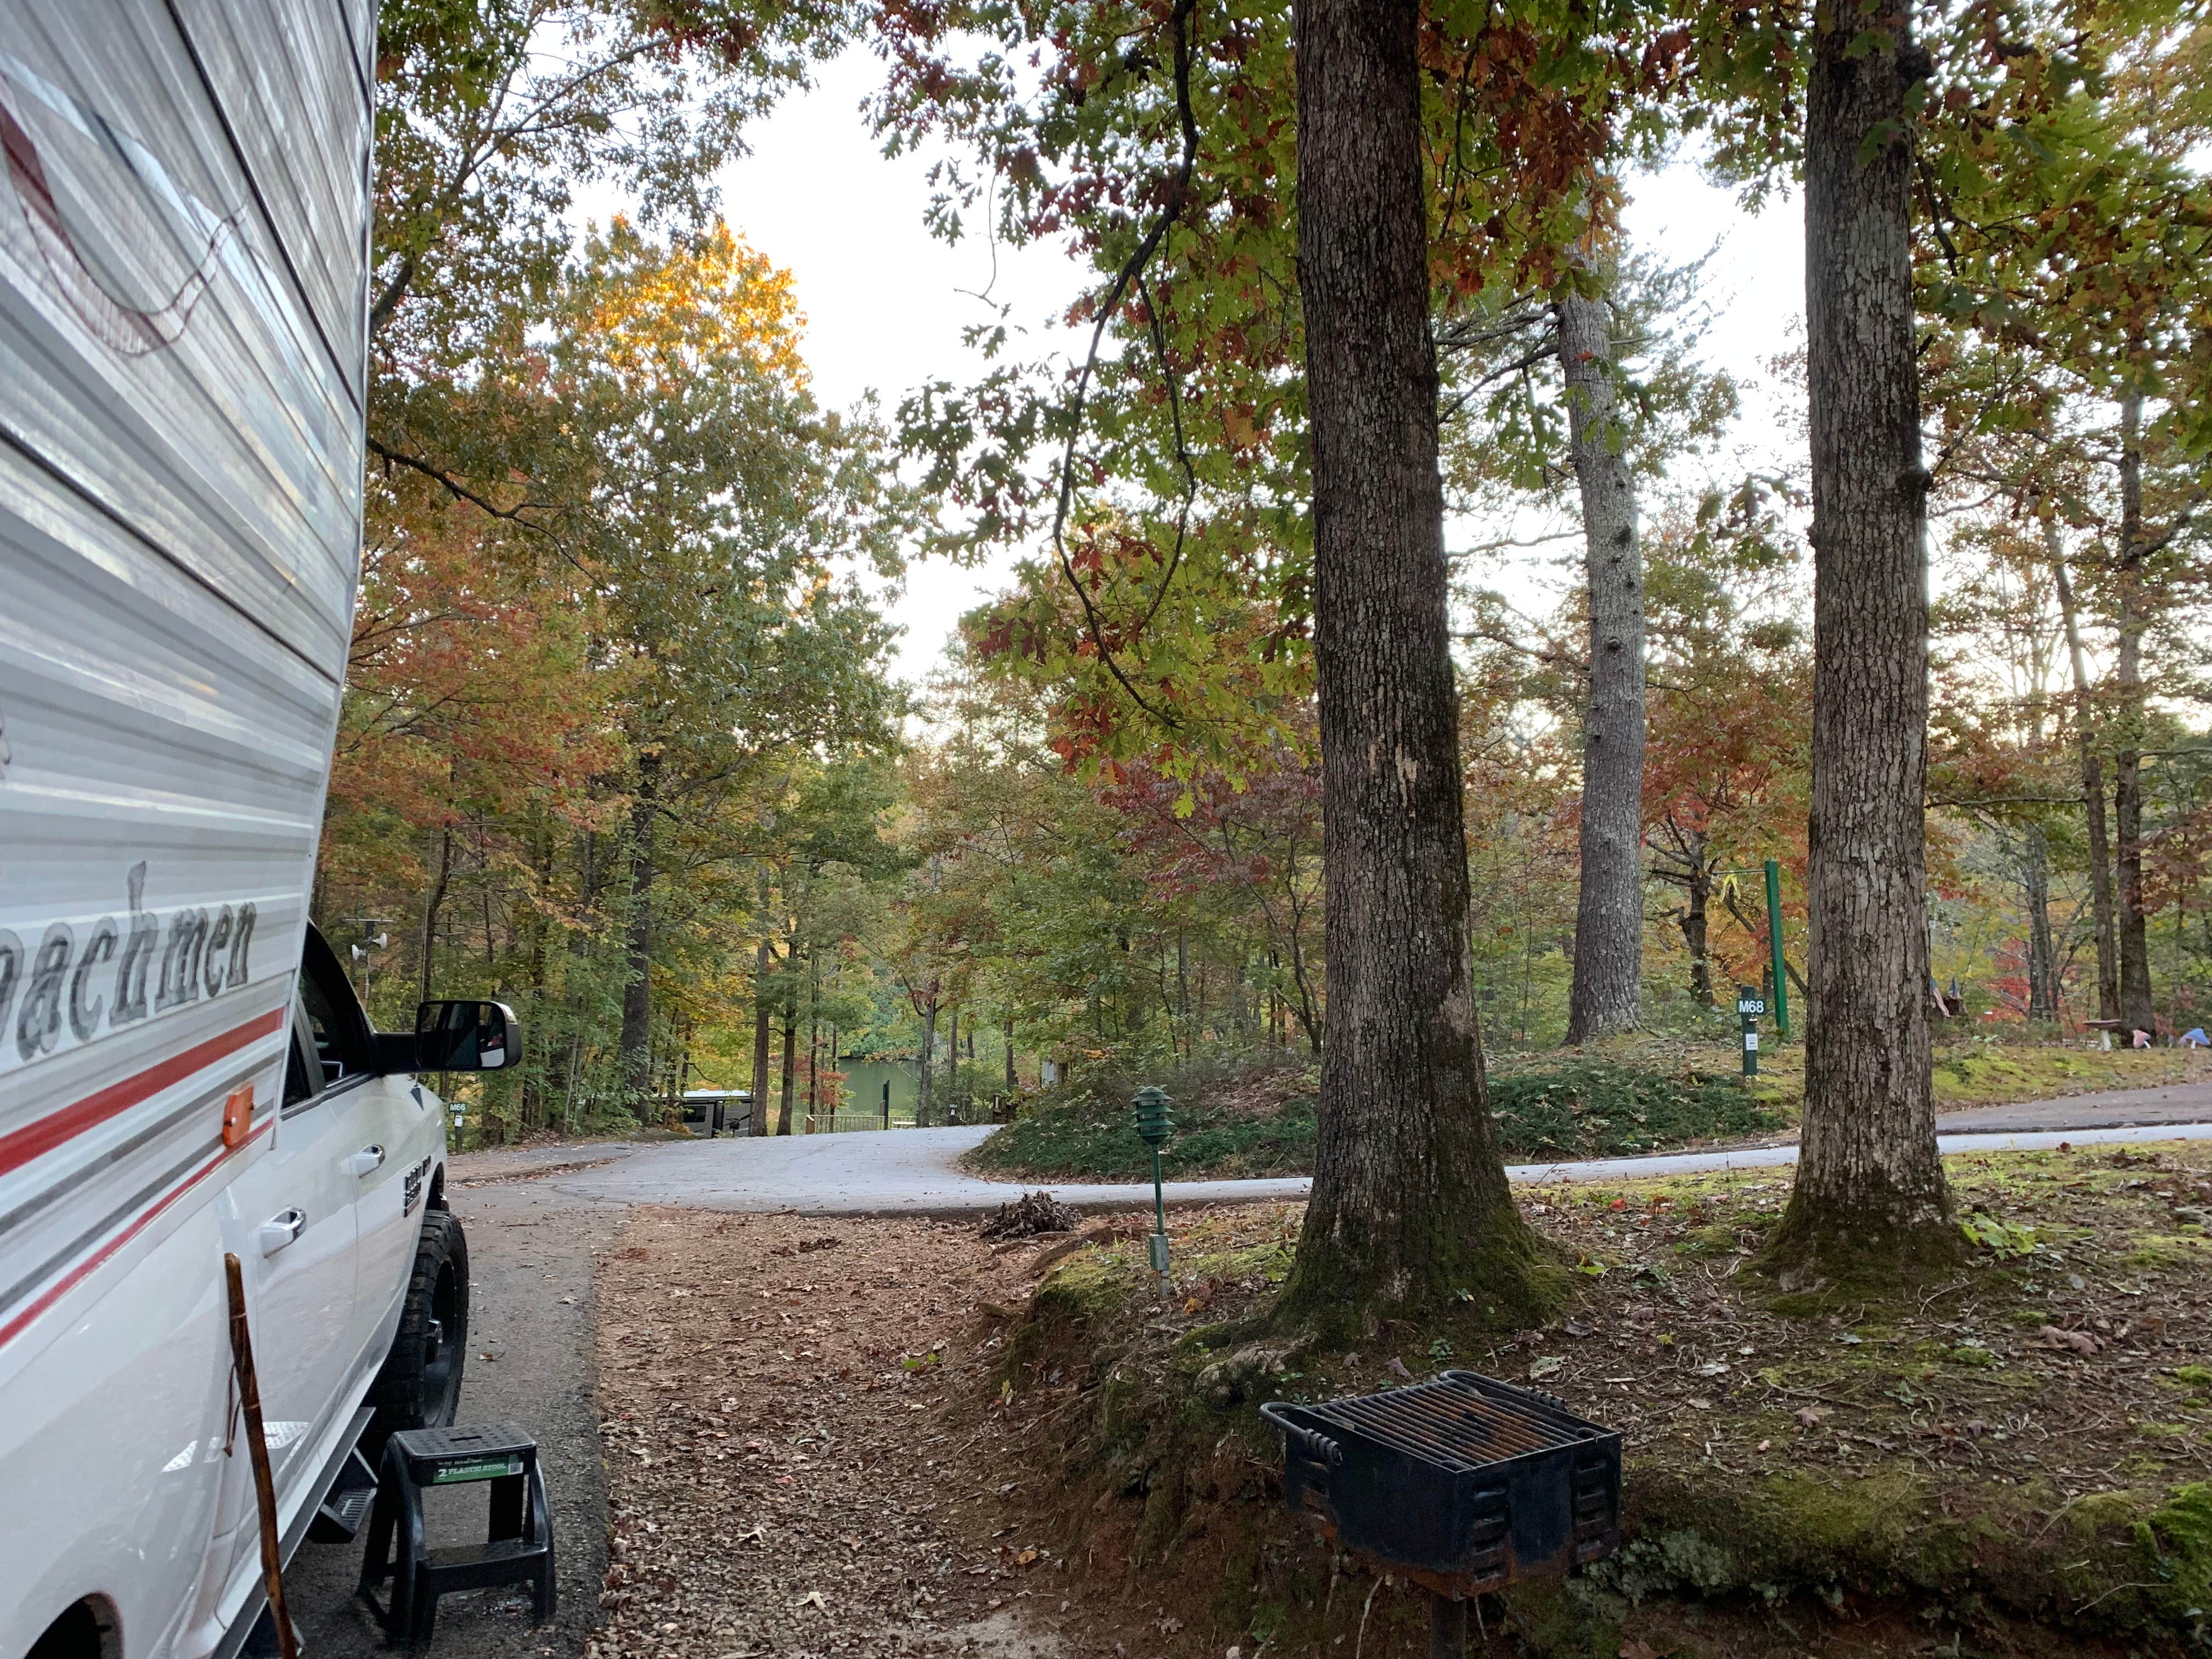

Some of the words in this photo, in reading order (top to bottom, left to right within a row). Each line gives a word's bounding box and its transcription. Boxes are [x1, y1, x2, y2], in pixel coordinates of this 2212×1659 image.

[1739, 1000, 1764, 1013] M68
[438, 1469, 448, 1477] 2
[447, 1465, 482, 1475] PLASTIC
